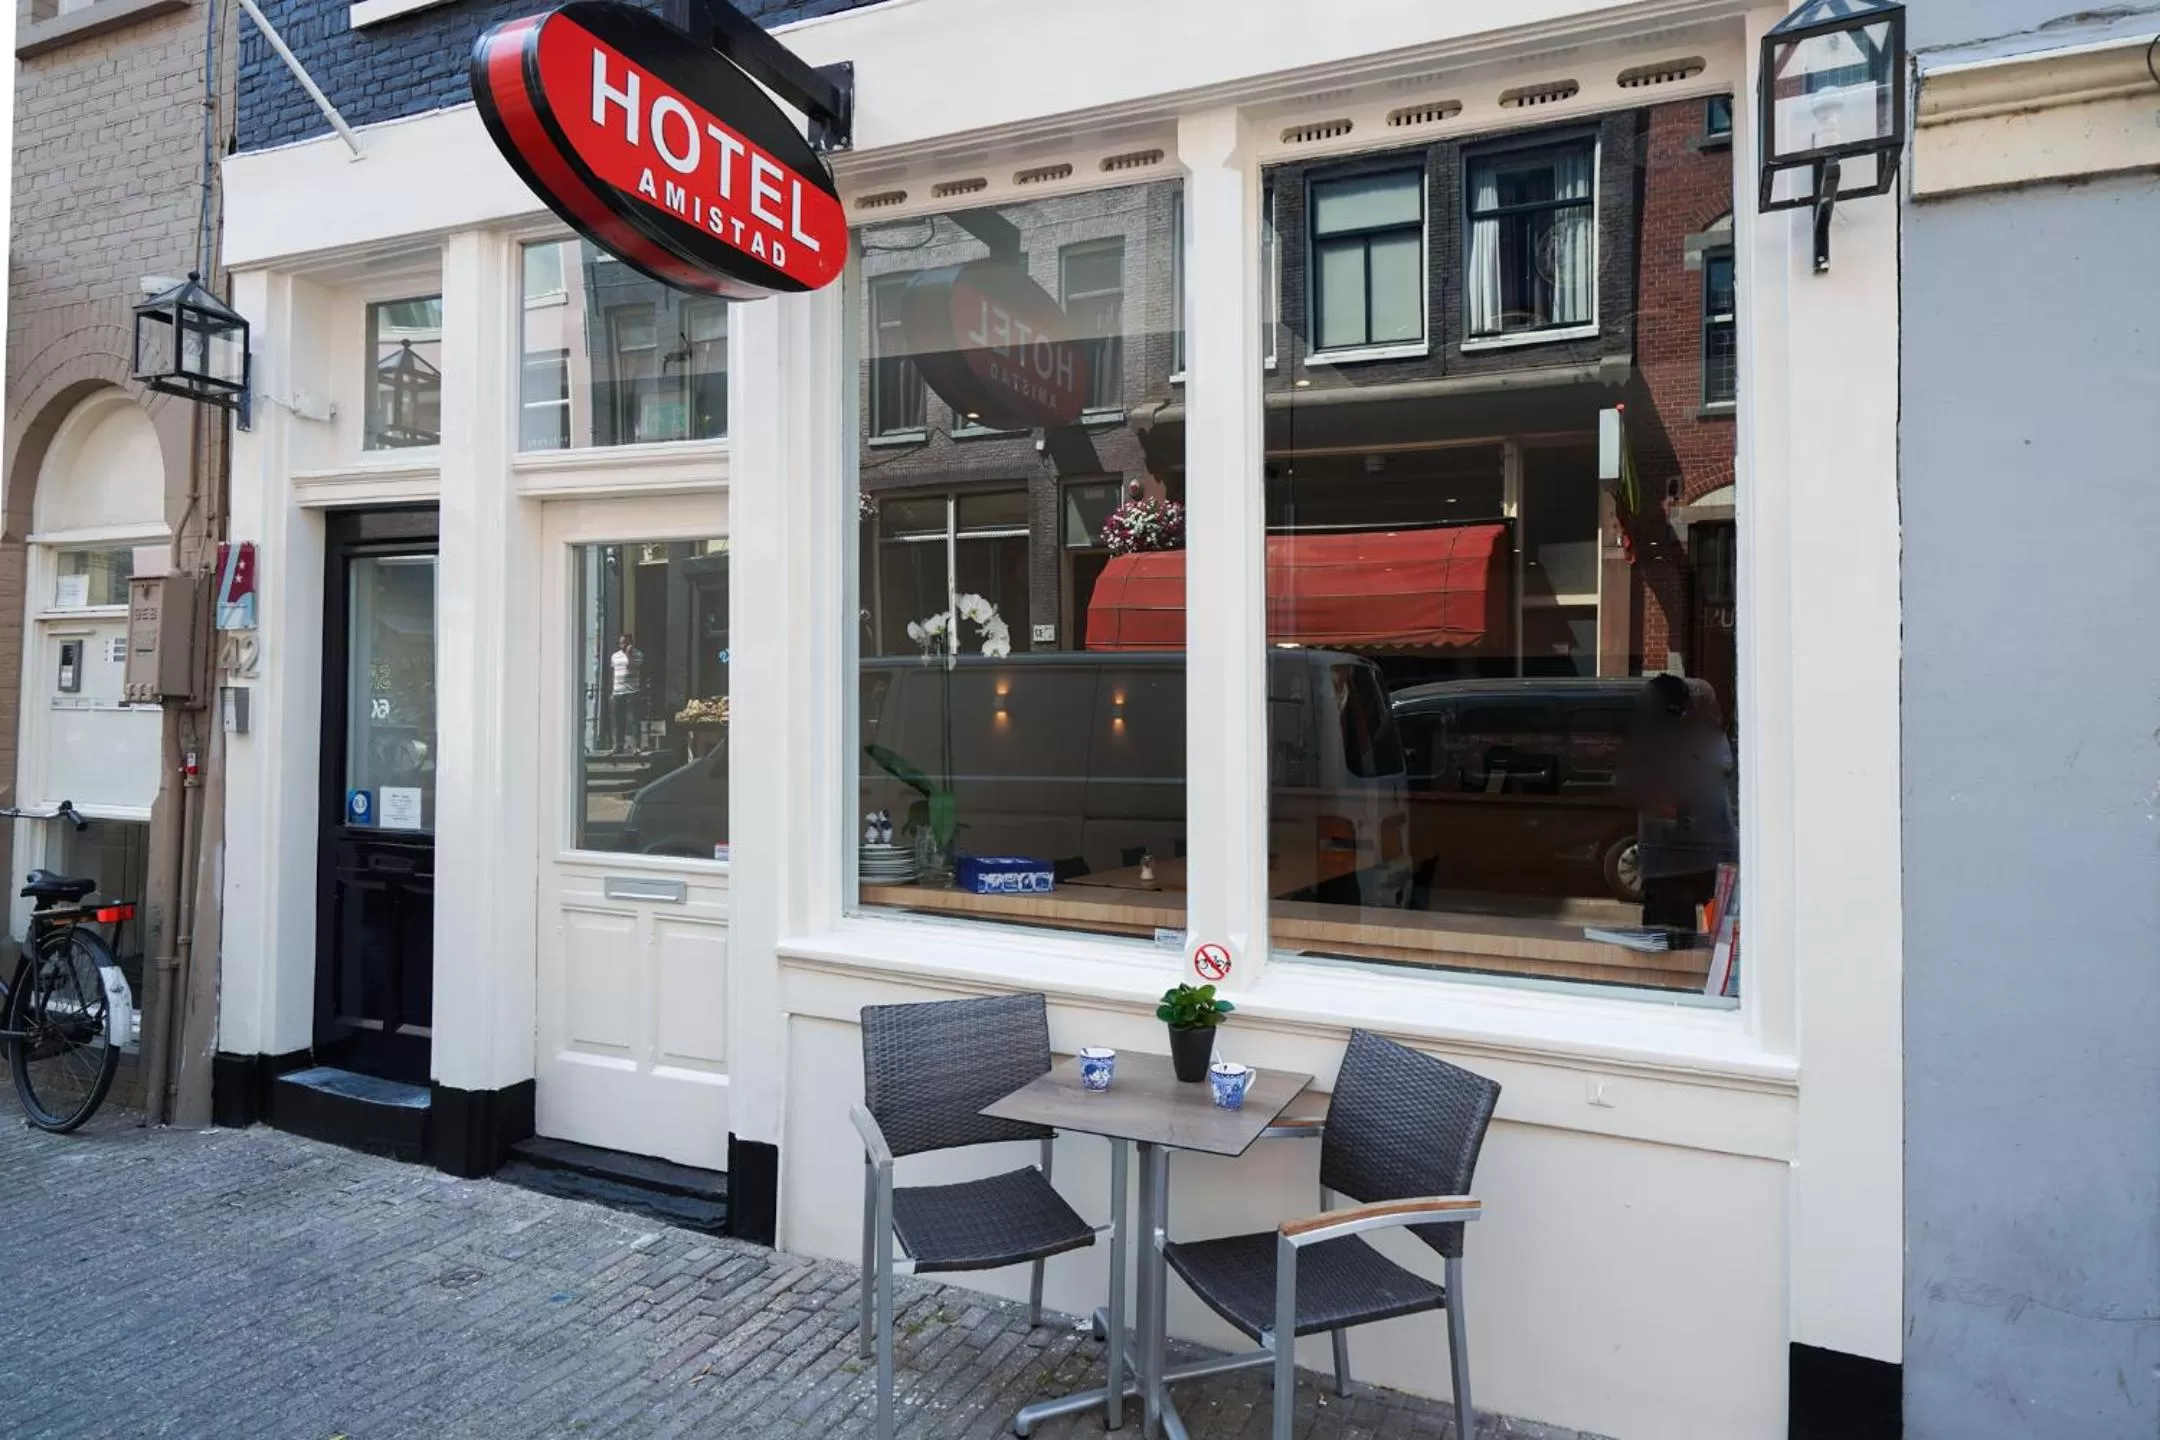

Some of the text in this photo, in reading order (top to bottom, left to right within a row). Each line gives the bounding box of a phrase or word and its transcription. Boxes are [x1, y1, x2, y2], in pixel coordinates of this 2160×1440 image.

[592, 47, 820, 252] HOTEL
[638, 167, 786, 268] AMISTAD
[219, 635, 260, 679] 42
